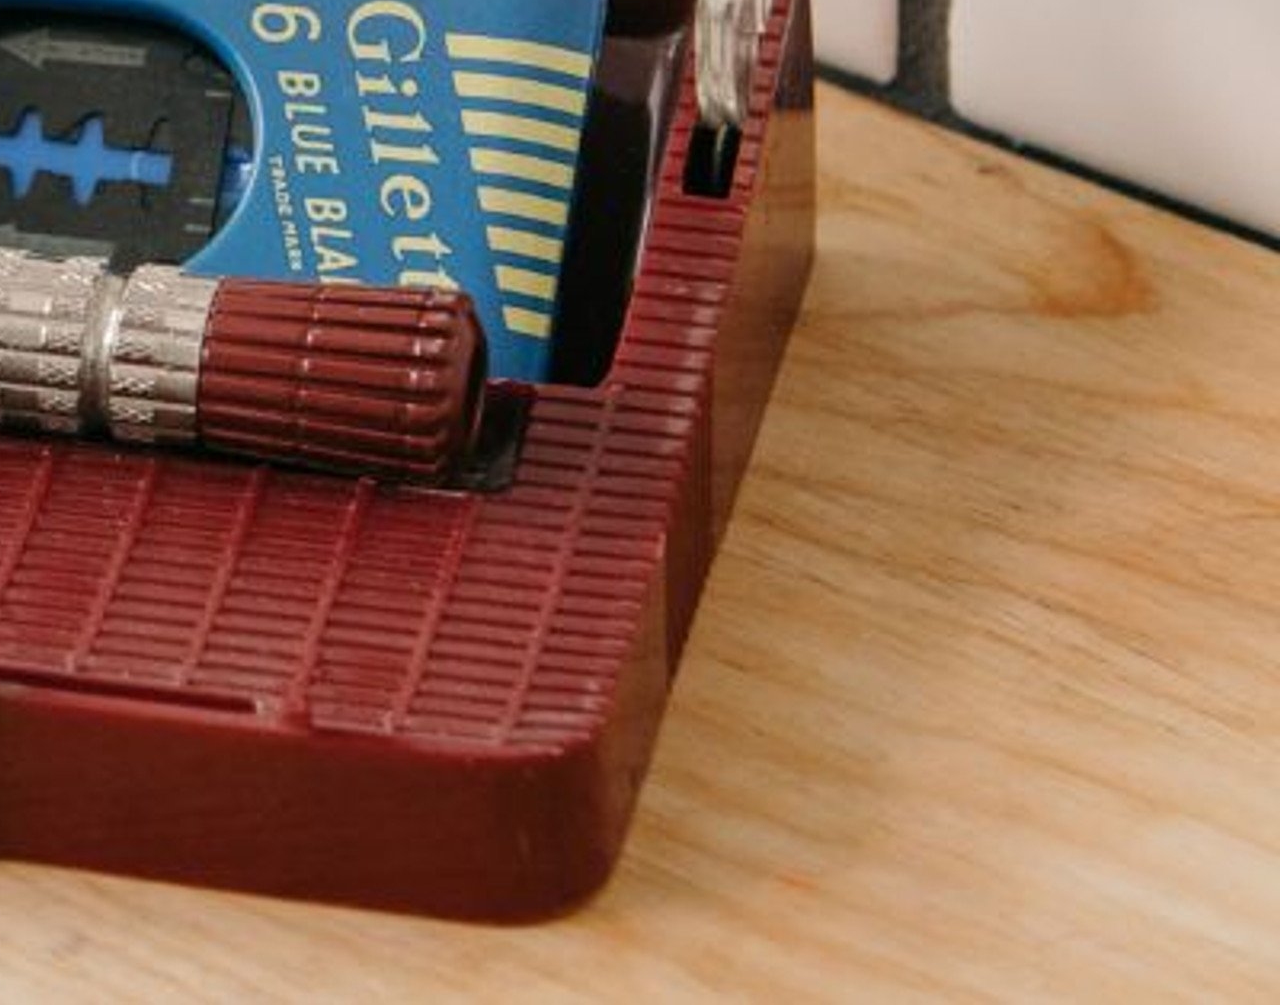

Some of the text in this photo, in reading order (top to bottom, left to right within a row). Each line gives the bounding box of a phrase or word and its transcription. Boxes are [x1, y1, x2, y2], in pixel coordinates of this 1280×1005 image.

[251, 2, 363, 286] 6 BLUE BLA
